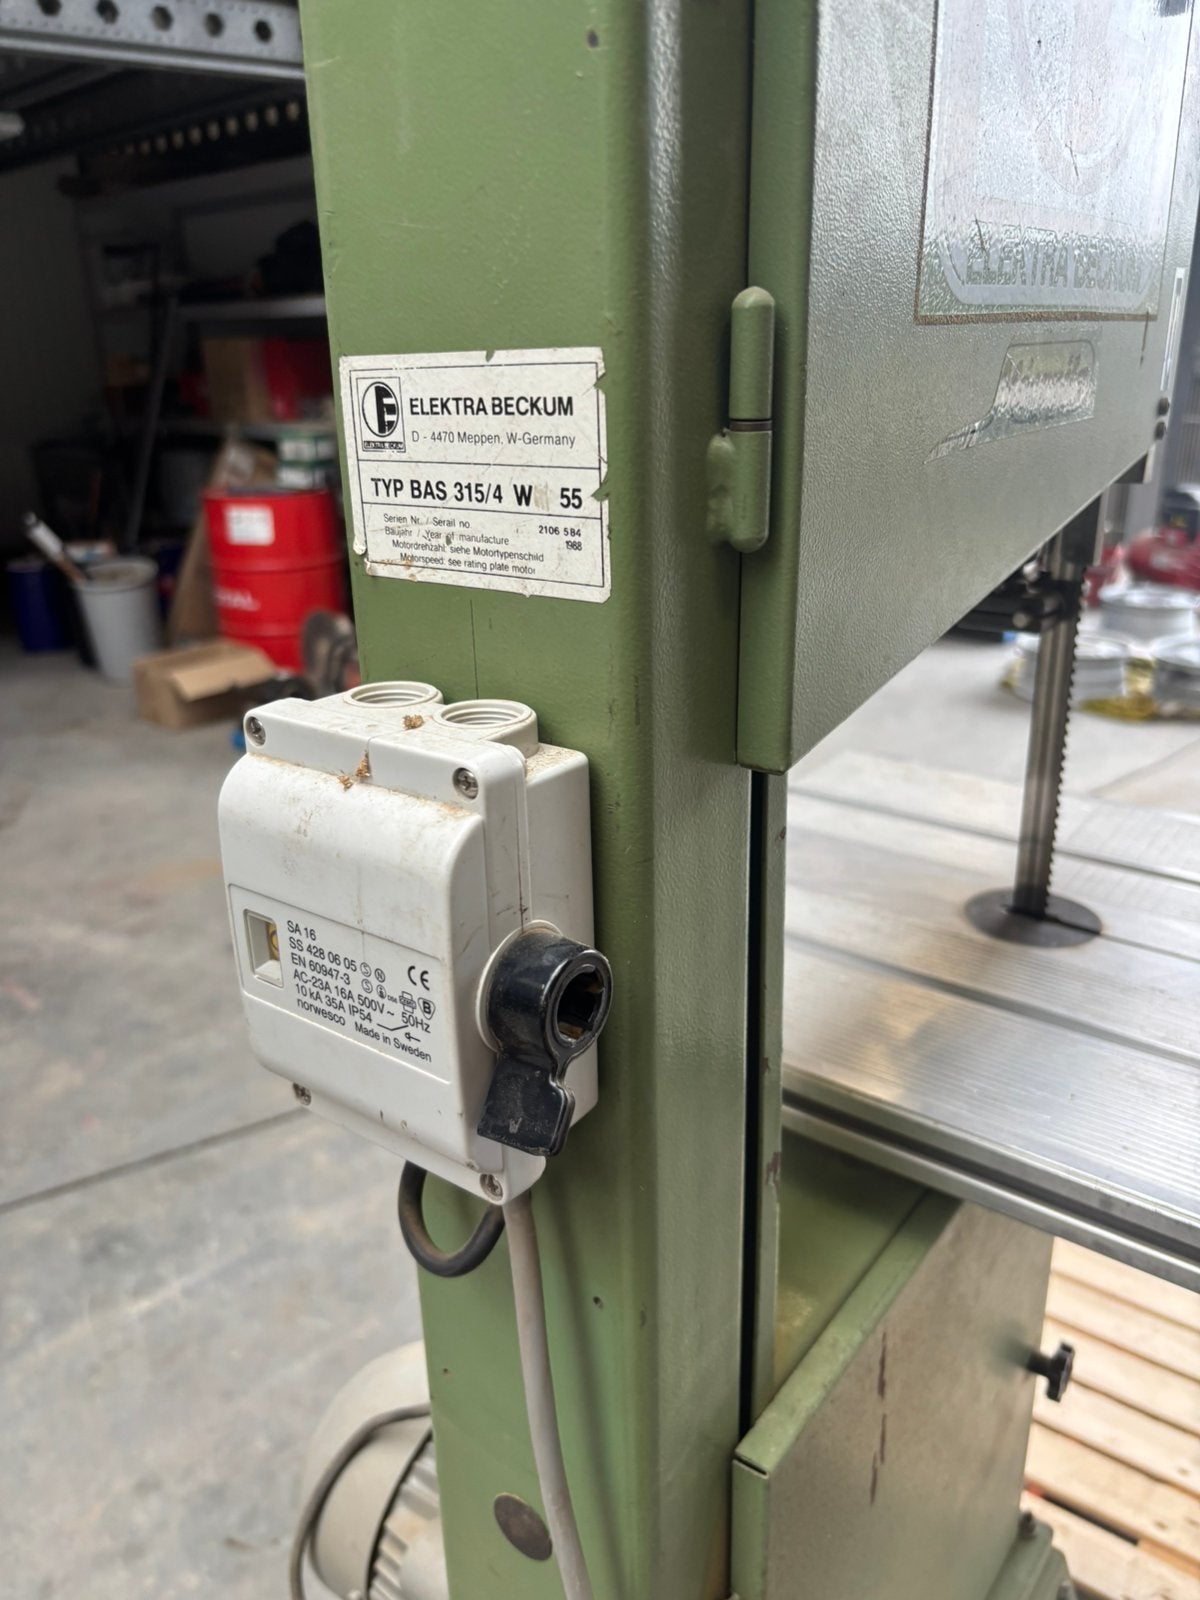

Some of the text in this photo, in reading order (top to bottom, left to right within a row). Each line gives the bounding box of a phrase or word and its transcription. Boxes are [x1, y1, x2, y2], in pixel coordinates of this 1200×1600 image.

[409, 396, 574, 416] ELEKTRA BECKUM
[412, 430, 420, 442] D
[430, 431, 455, 443] 4470
[506, 432, 576, 449] W-Germany
[370, 477, 583, 509] TYP BAS 315/4 W 55
[383, 513, 408, 524] Serien
[432, 516, 456, 528] Serail
[538, 524, 560, 536] 2106
[384, 526, 413, 538] Baujahr
[424, 529, 442, 539] Year
[458, 533, 510, 546] manufacture
[565, 540, 583, 551] 1988
[449, 545, 471, 555] siehe
[472, 546, 545, 562] Motortypenschild
[447, 557, 462, 567] see
[464, 559, 488, 571] rating
[489, 561, 510, 571] plate
[511, 564, 536, 574] motor
[286, 919, 317, 941] SA 16
[289, 936, 304, 952] SS
[306, 944, 326, 960] 428
[327, 951, 341, 966] 06
[343, 957, 357, 972] 05
[290, 952, 307, 968] EN
[308, 960, 351, 986] 60947-3
[293, 969, 332, 994] AC-23A
[334, 985, 355, 1003] 16A
[357, 993, 385, 1014] 500V
[401, 1011, 431, 1034] 50Hz
[296, 983, 373, 1024] 10 kA 35A IP54
[296, 998, 432, 1063] norwesco Made in Sweden
